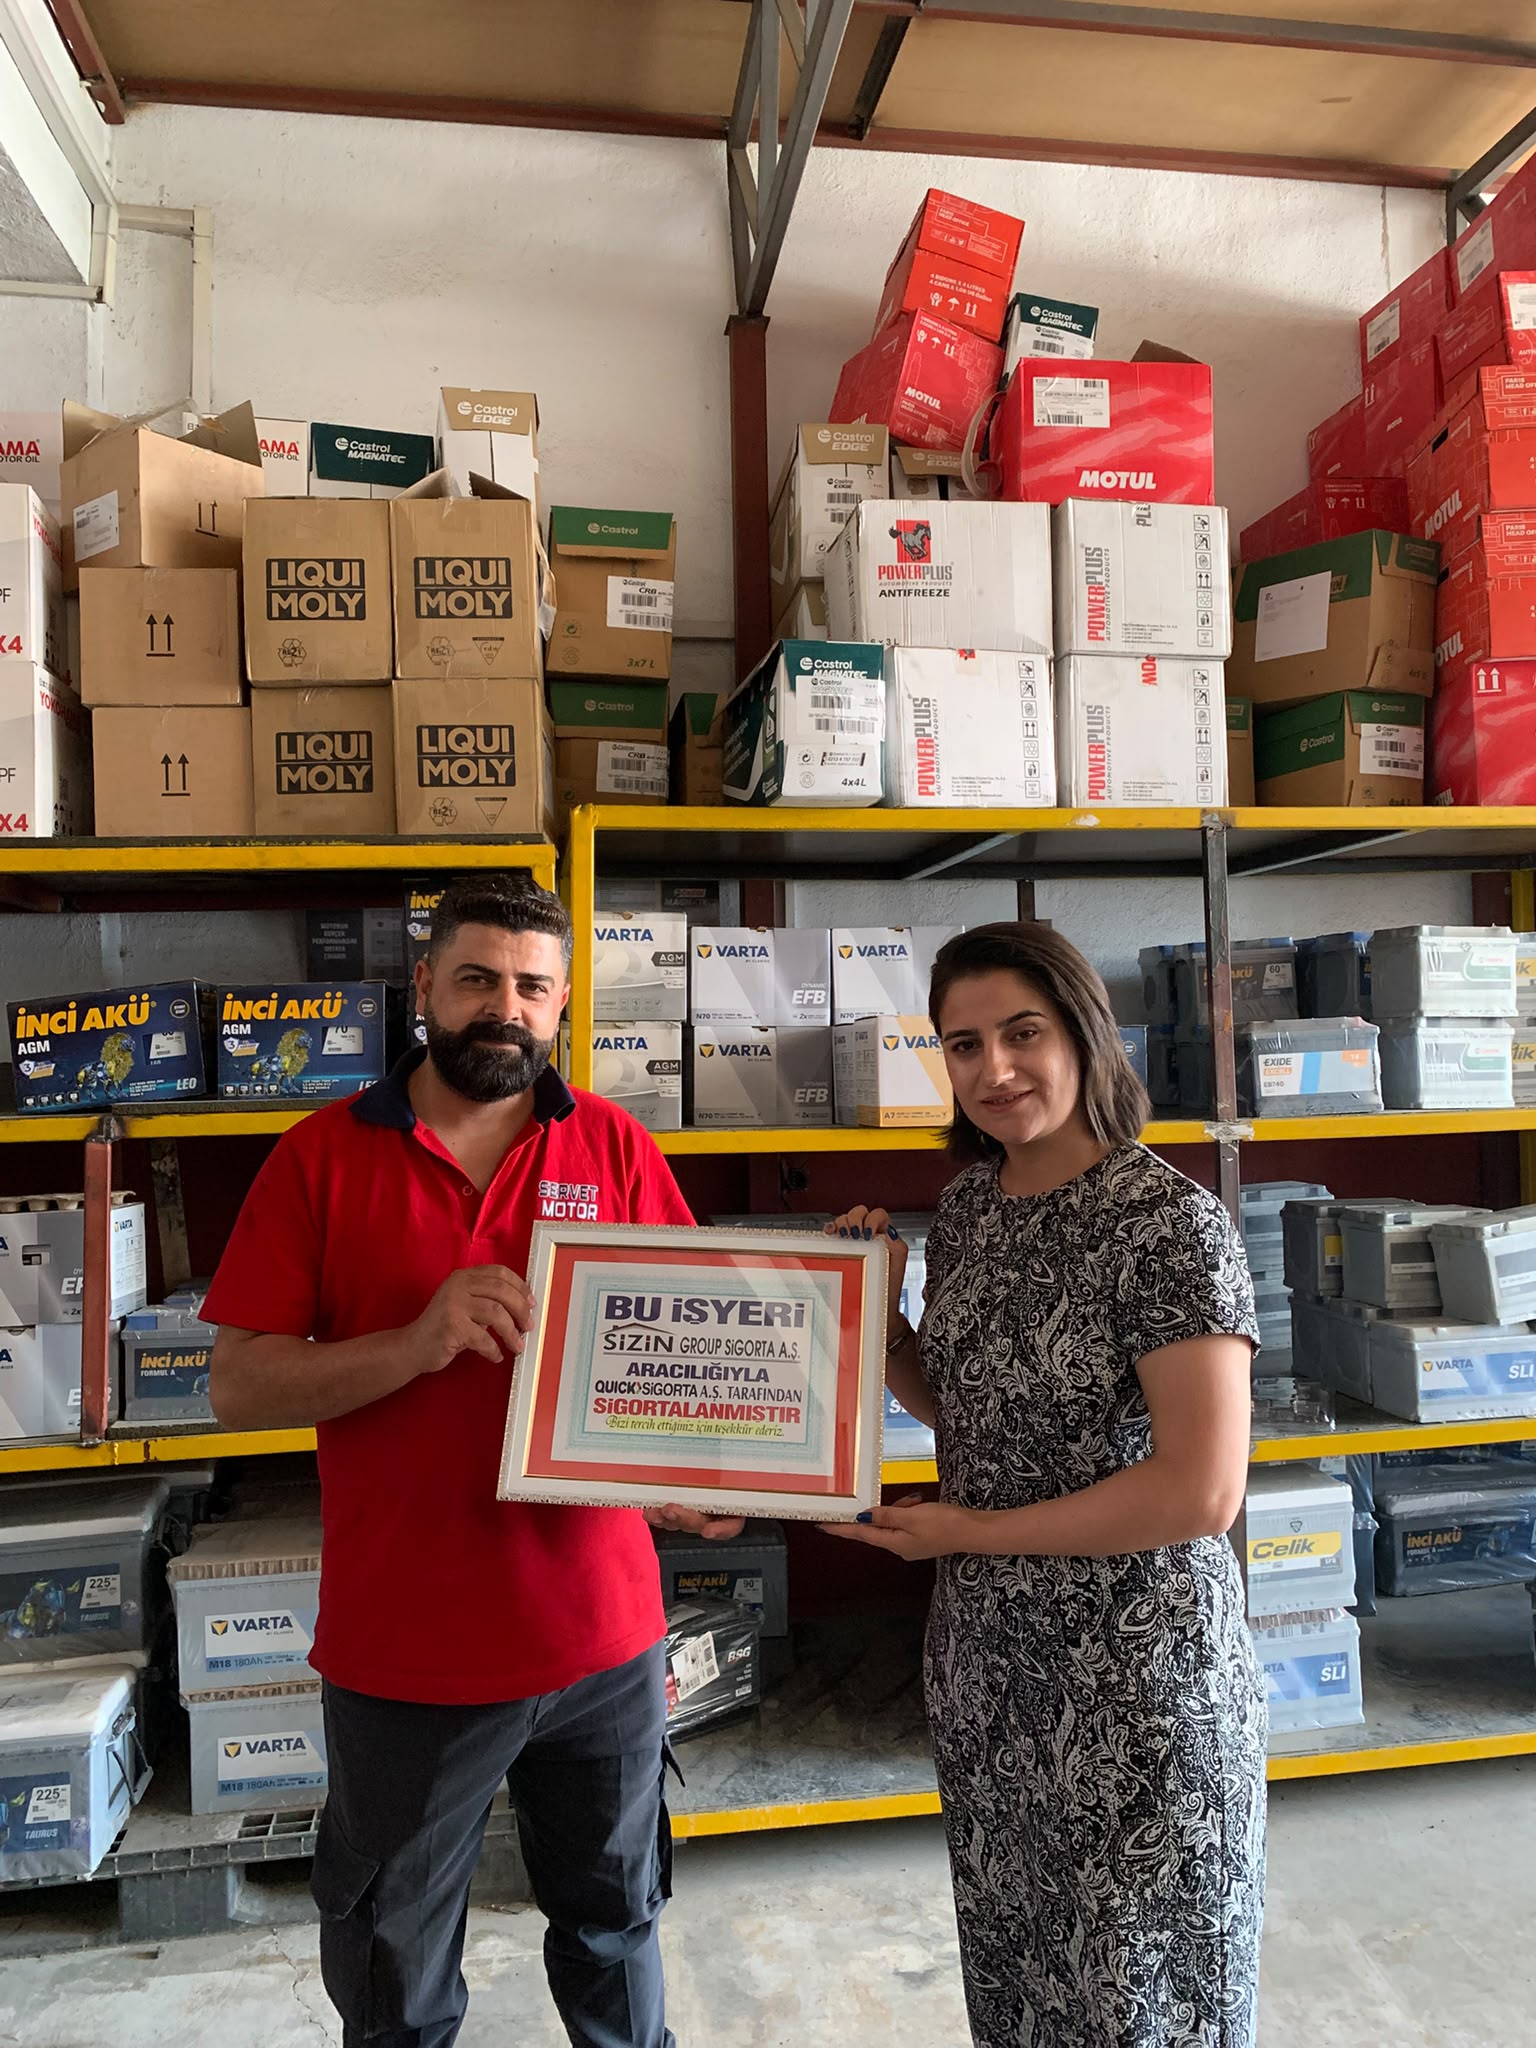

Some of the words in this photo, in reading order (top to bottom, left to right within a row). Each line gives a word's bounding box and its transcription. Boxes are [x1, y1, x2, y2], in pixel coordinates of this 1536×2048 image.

[1042, 309, 1072, 321] Castrol
[1040, 316, 1084, 332] MAGNATEC
[905, 387, 941, 409] MOTUL
[474, 402, 518, 416] Castrol
[473, 415, 512, 424] EDGE
[833, 432, 875, 442] Castrol
[350, 440, 392, 453] Castrol
[832, 443, 869, 452] EDGE
[347, 450, 406, 468] MAGNATEC
[1078, 471, 1156, 489] MOTUL
[1425, 488, 1463, 540] MOTUL
[601, 527, 638, 537] Castrol
[271, 560, 360, 587] LIQUI
[418, 559, 507, 586] LIQUI
[878, 565, 952, 580] POWERPLUS
[878, 589, 950, 597] ANTIFREEZE
[1085, 547, 1105, 641] POWERPLUS
[272, 591, 363, 618] MOLY
[420, 589, 510, 616] MOLY
[627, 658, 647, 667] 3x7
[814, 659, 852, 669] Castrol
[813, 669, 868, 679] MAGNATEC
[598, 702, 634, 711] Castrol
[280, 734, 368, 760] LIQUI
[422, 727, 510, 754] LIQUI
[912, 697, 935, 796] POWERPLUS
[1309, 733, 1335, 748] Castrol
[1086, 704, 1105, 800] POWERPLUS
[282, 764, 371, 791] MOLY
[422, 758, 512, 784] MOLY
[411, 926, 419, 934] 3
[594, 928, 654, 941] VARTA
[716, 946, 769, 958] VARTA
[856, 945, 908, 957] VARTA
[1269, 965, 1280, 974] 60
[280, 991, 342, 1019] AKÜ
[792, 990, 826, 1005] EFB
[82, 993, 150, 1031] AKÜ
[222, 1024, 251, 1035] AGM
[18, 1040, 50, 1055] AGM
[229, 1040, 235, 1050] 3
[592, 1037, 648, 1049] VARTA
[719, 1044, 772, 1056] VARTA
[903, 1036, 941, 1049] VAR
[24, 1063, 32, 1074] 3
[1263, 1057, 1293, 1067] EXIDE
[176, 1078, 197, 1090] LEO
[794, 1088, 829, 1103] EFB
[884, 1109, 895, 1119] A7
[538, 1180, 598, 1201] SERVET
[542, 1201, 598, 1220] MOTOR
[604, 1296, 662, 1322] BU
[671, 1297, 805, 1328] İŞYERİ
[680, 1337, 722, 1355] GROUP
[173, 1350, 207, 1368] AKÜ
[1436, 1359, 1474, 1374] VARTA
[626, 1361, 769, 1383] ARACILIĞIYLA
[1508, 1364, 1534, 1379] SLI
[594, 1380, 635, 1395] QUICK
[728, 1386, 802, 1403] TARAFINDAN
[606, 1415, 630, 1429] Bizi
[632, 1418, 655, 1430] tercih
[657, 1420, 694, 1435] ettiğiniz
[696, 1421, 713, 1434] için
[715, 1422, 752, 1436] teşekkür
[1433, 1526, 1462, 1546] AKÜ
[1252, 1538, 1315, 1560] Celik
[89, 1577, 111, 1588] 225
[743, 1580, 754, 1588] 90
[80, 1612, 110, 1622] TAURUS
[232, 1616, 293, 1633] VARTA
[727, 1646, 752, 1663] BSG
[209, 1659, 232, 1669] M18
[234, 1656, 263, 1668] 180Ah
[1320, 1666, 1346, 1682] SLI
[245, 1737, 306, 1754] VARTA
[221, 1780, 244, 1792] M18
[247, 1780, 275, 1792] 180Ah
[36, 1788, 61, 1801] 225
[25, 1828, 58, 1840] TAURUS
